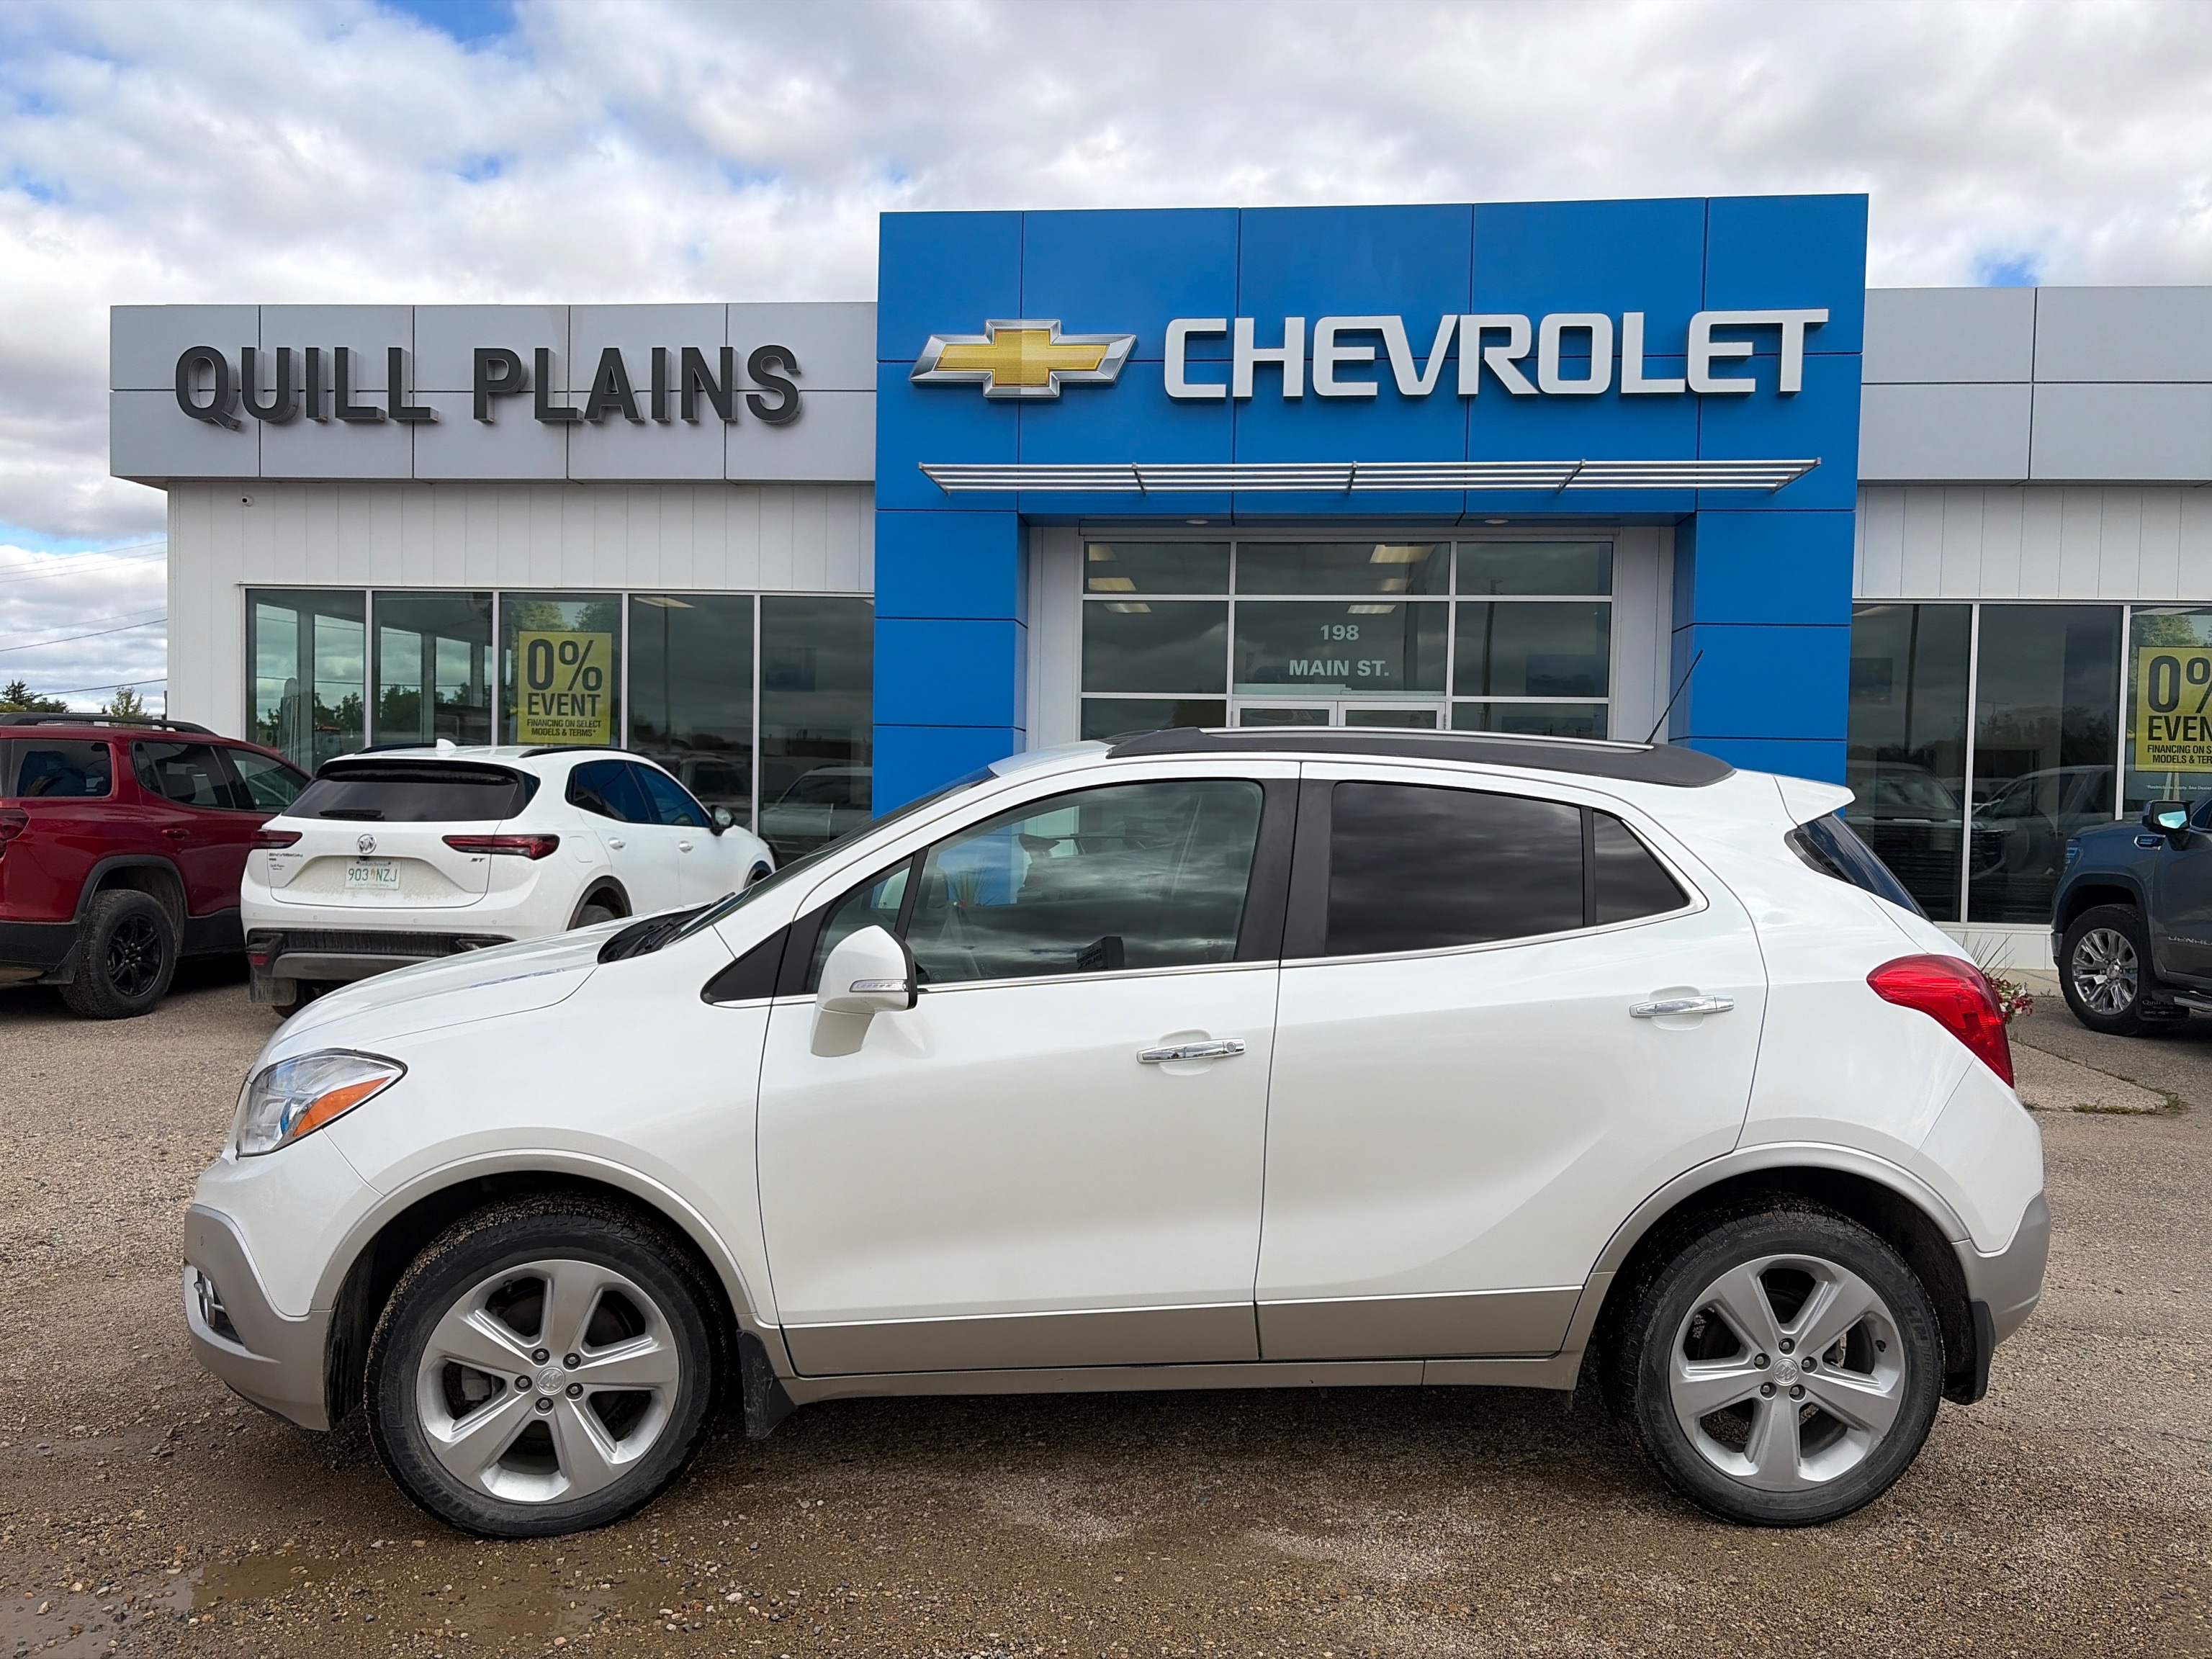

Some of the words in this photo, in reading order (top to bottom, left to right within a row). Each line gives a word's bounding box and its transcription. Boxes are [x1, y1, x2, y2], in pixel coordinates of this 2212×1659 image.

[1164, 308, 1829, 398] CHEVROLET
[175, 346, 439, 430] QUILL
[474, 346, 803, 425] PLAINS
[1321, 624, 1359, 641] 198
[528, 639, 603, 691] 0%
[1289, 660, 1349, 676] MAIN
[1357, 660, 1389, 676] ST.
[528, 693, 601, 717] EVENT
[527, 719, 563, 727] FINANCING
[2147, 745, 2190, 754] FINANCING
[2193, 745, 2204, 754] ON
[2152, 755, 2187, 763] MODELS
[348, 868, 369, 881] 903
[376, 868, 397, 882] NZJ
